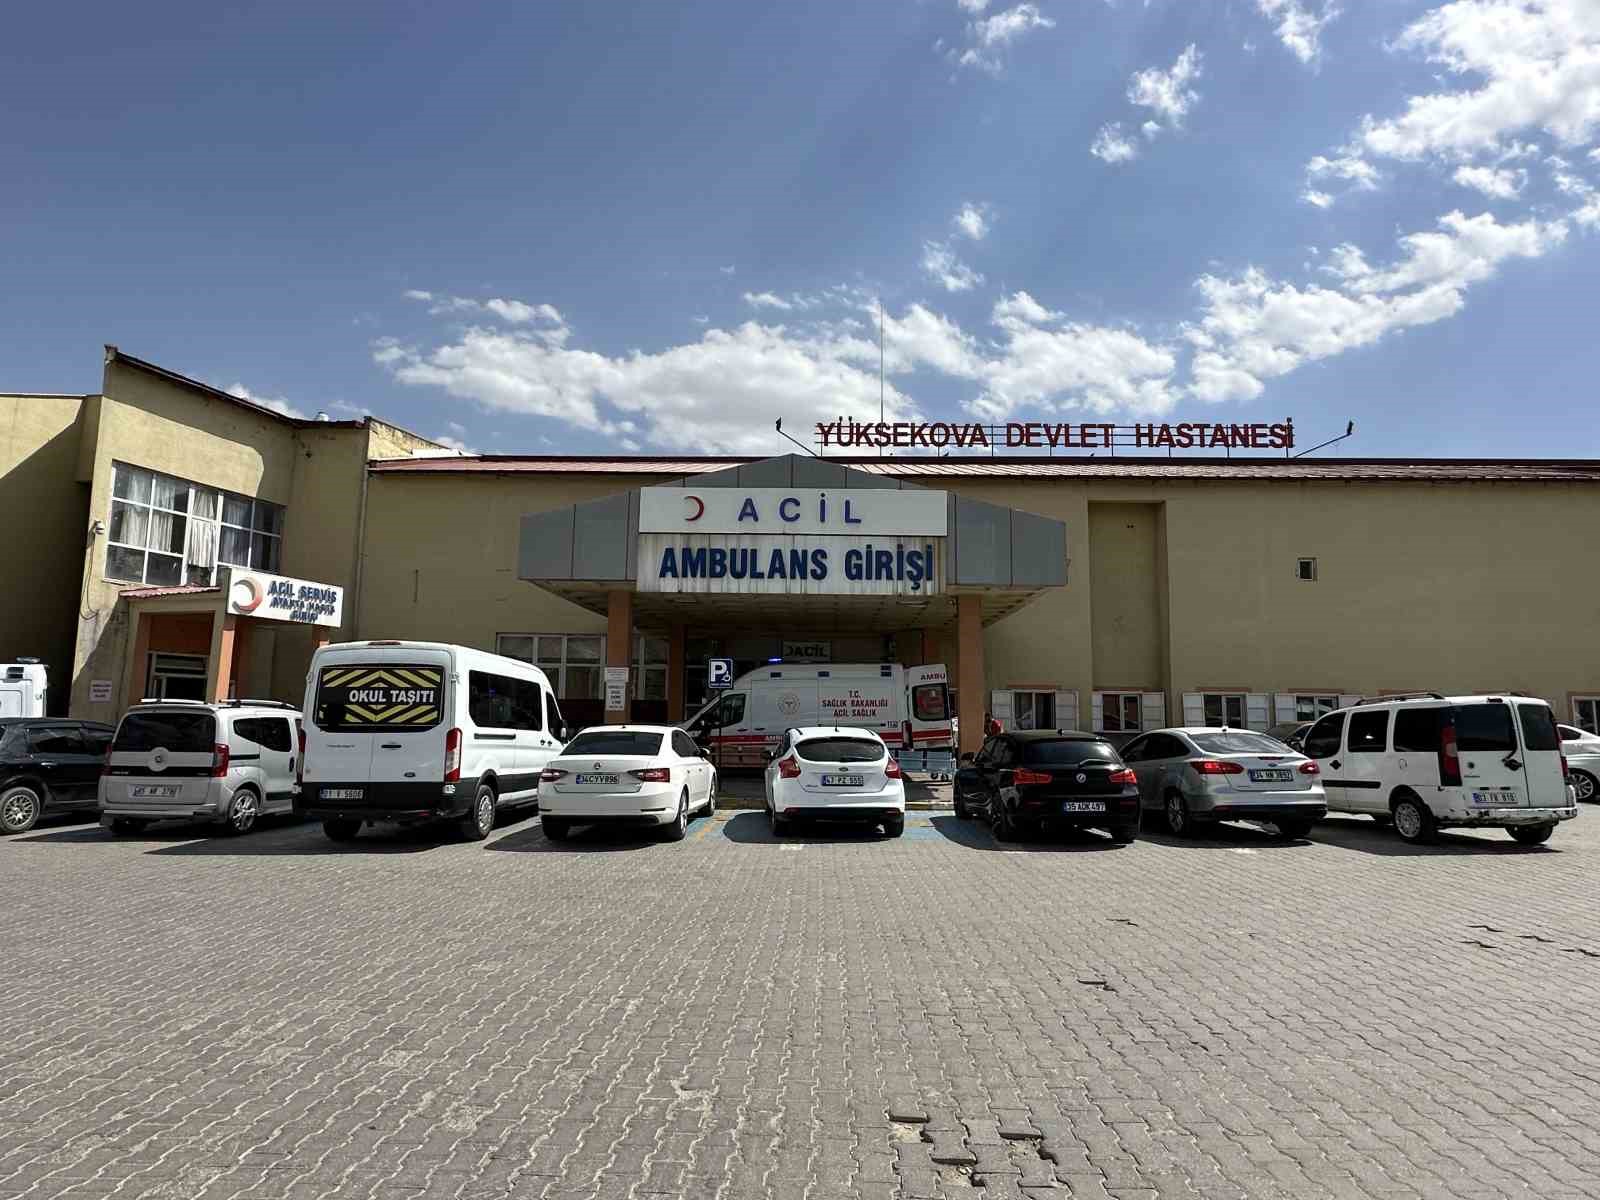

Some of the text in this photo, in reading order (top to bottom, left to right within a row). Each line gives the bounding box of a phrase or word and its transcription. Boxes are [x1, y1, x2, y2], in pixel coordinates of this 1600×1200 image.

[816, 416, 1294, 449] YÜKSEKOVA DEVLET HASTANESİ
[737, 493, 863, 524] ACİL
[658, 543, 934, 591] AMBULANS GİRİŞİ
[267, 580, 296, 597] ACİL
[710, 661, 728, 682] P
[348, 689, 435, 706] OKUL TAŞITI
[821, 698, 847, 708] SAĞLIK
